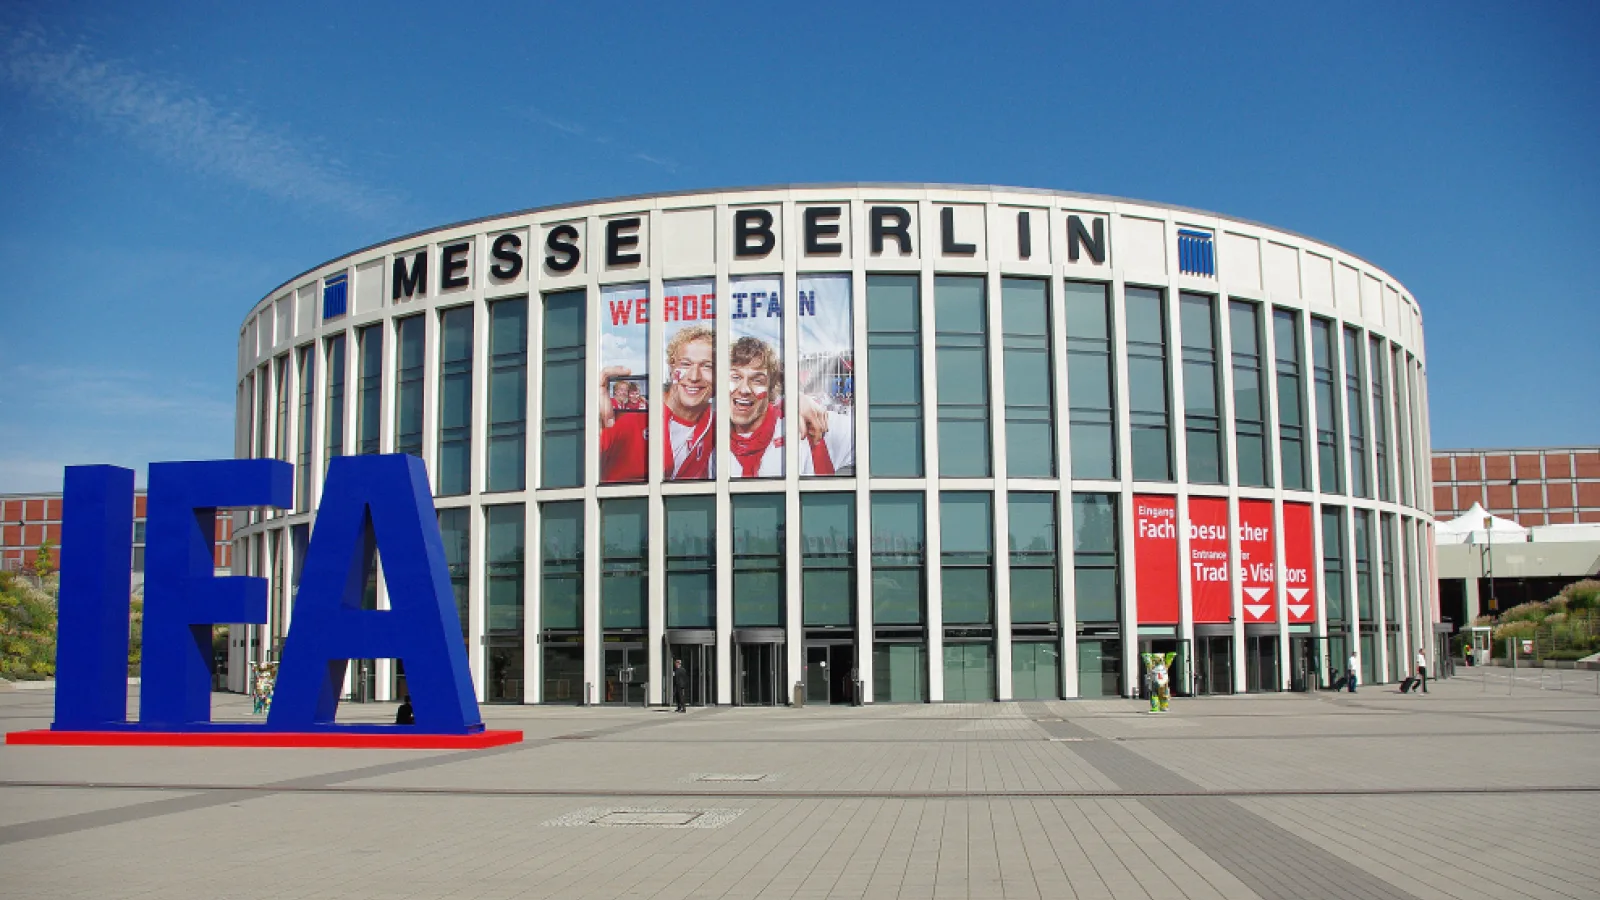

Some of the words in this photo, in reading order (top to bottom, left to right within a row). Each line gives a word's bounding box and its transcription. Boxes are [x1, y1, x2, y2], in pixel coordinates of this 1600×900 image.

[392, 217, 642, 301] MESSE
[734, 206, 1106, 263] BERLIN
[609, 293, 717, 326] WERDE
[1138, 505, 1175, 519] Eingang
[1192, 549, 1227, 560] Entrance
[1193, 562, 1248, 582] Trade
[51, 453, 484, 733] IFA
